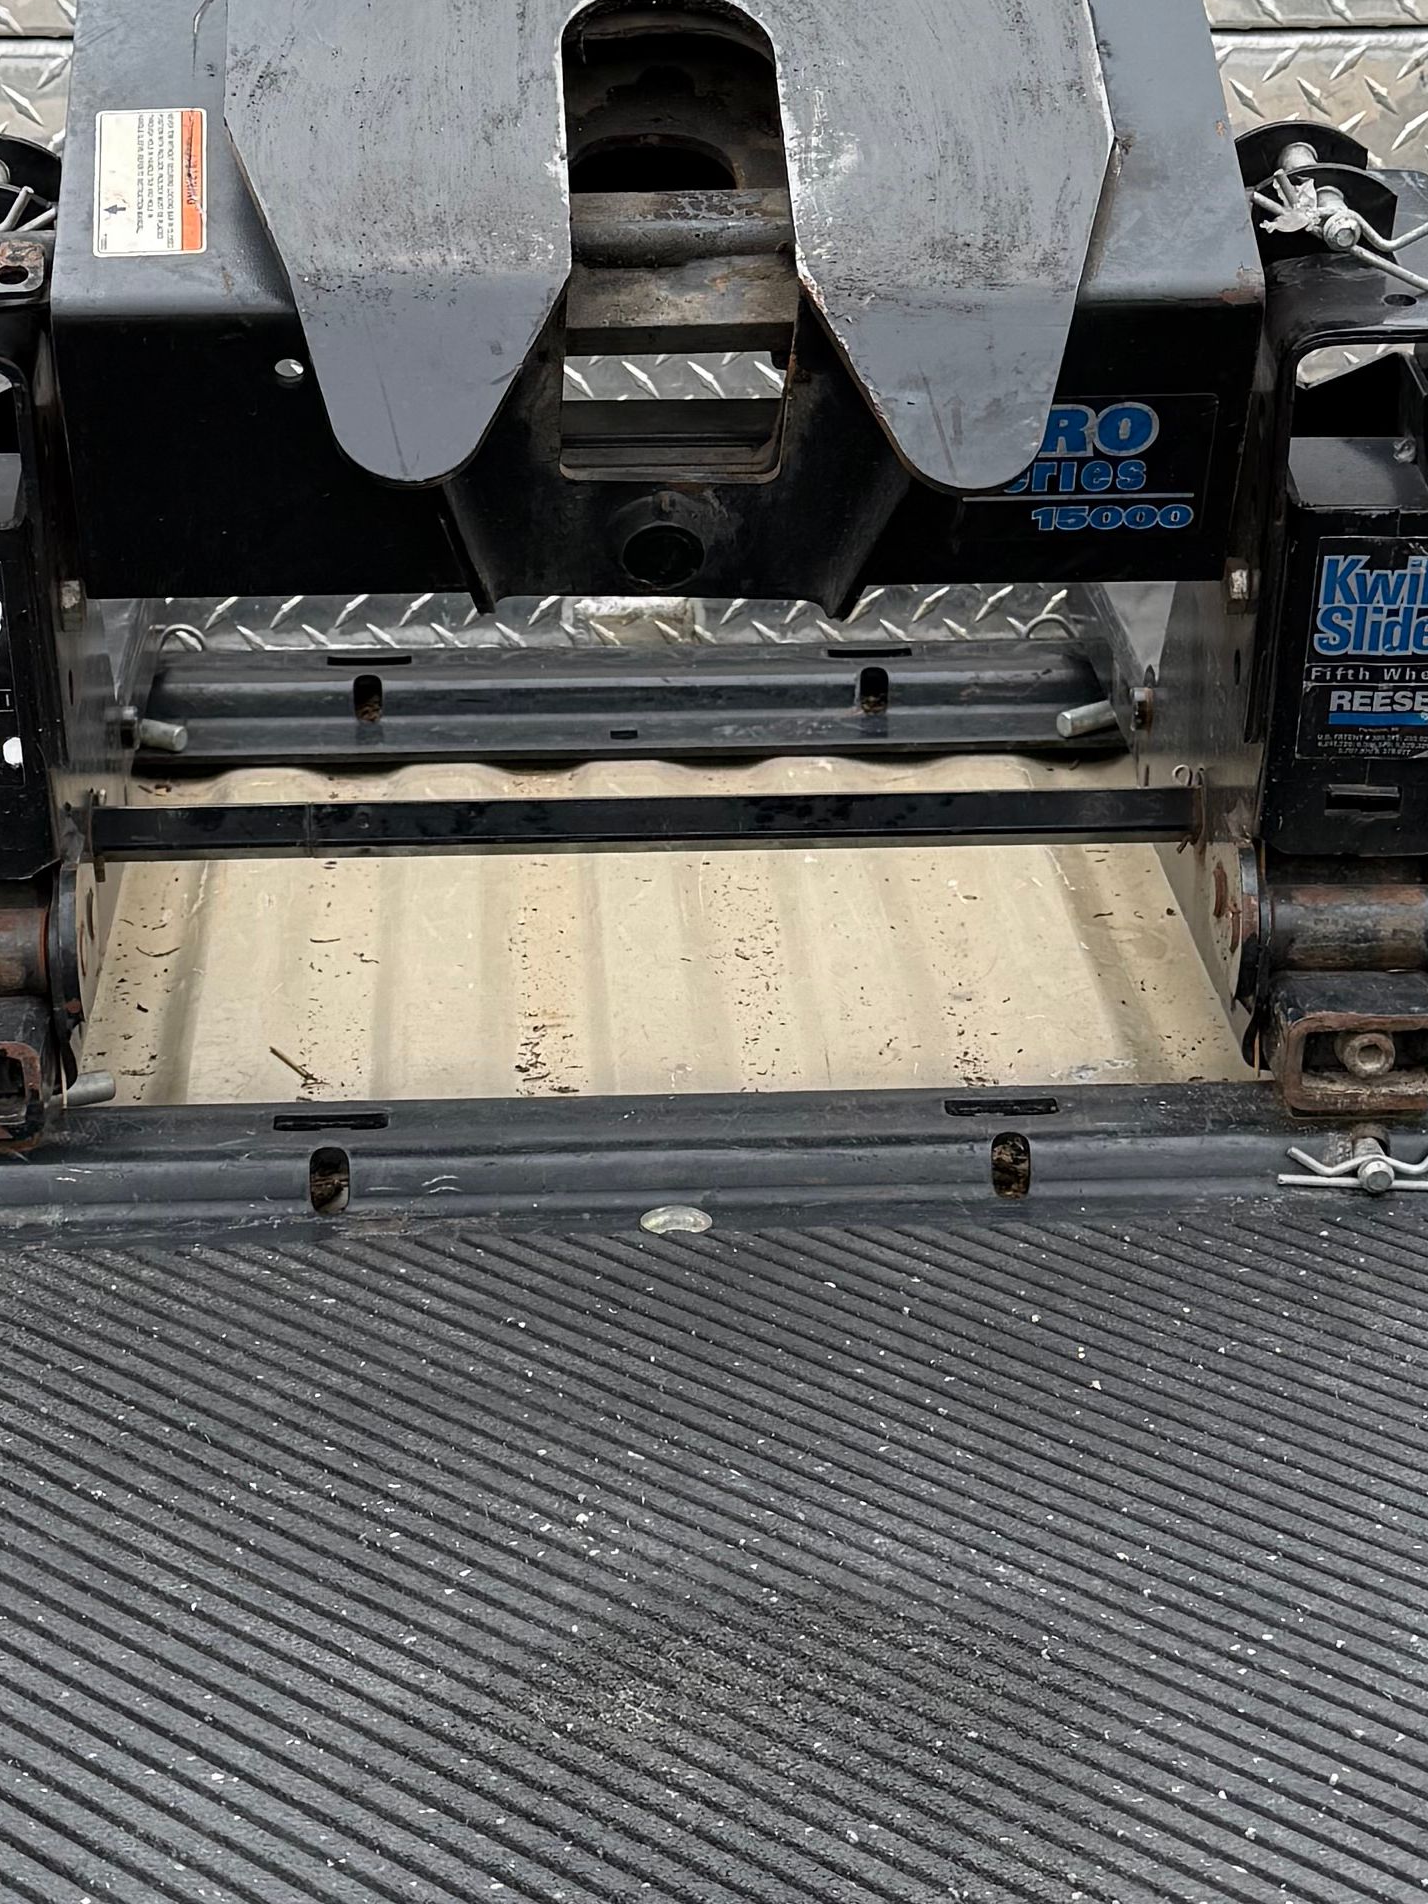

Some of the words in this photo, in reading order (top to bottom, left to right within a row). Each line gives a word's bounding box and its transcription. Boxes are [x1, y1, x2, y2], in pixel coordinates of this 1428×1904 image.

[1037, 402, 1160, 458] RO
[1004, 460, 1147, 494] ries
[1031, 504, 1194, 531] 15000
[1311, 667, 1370, 680] Fifth
